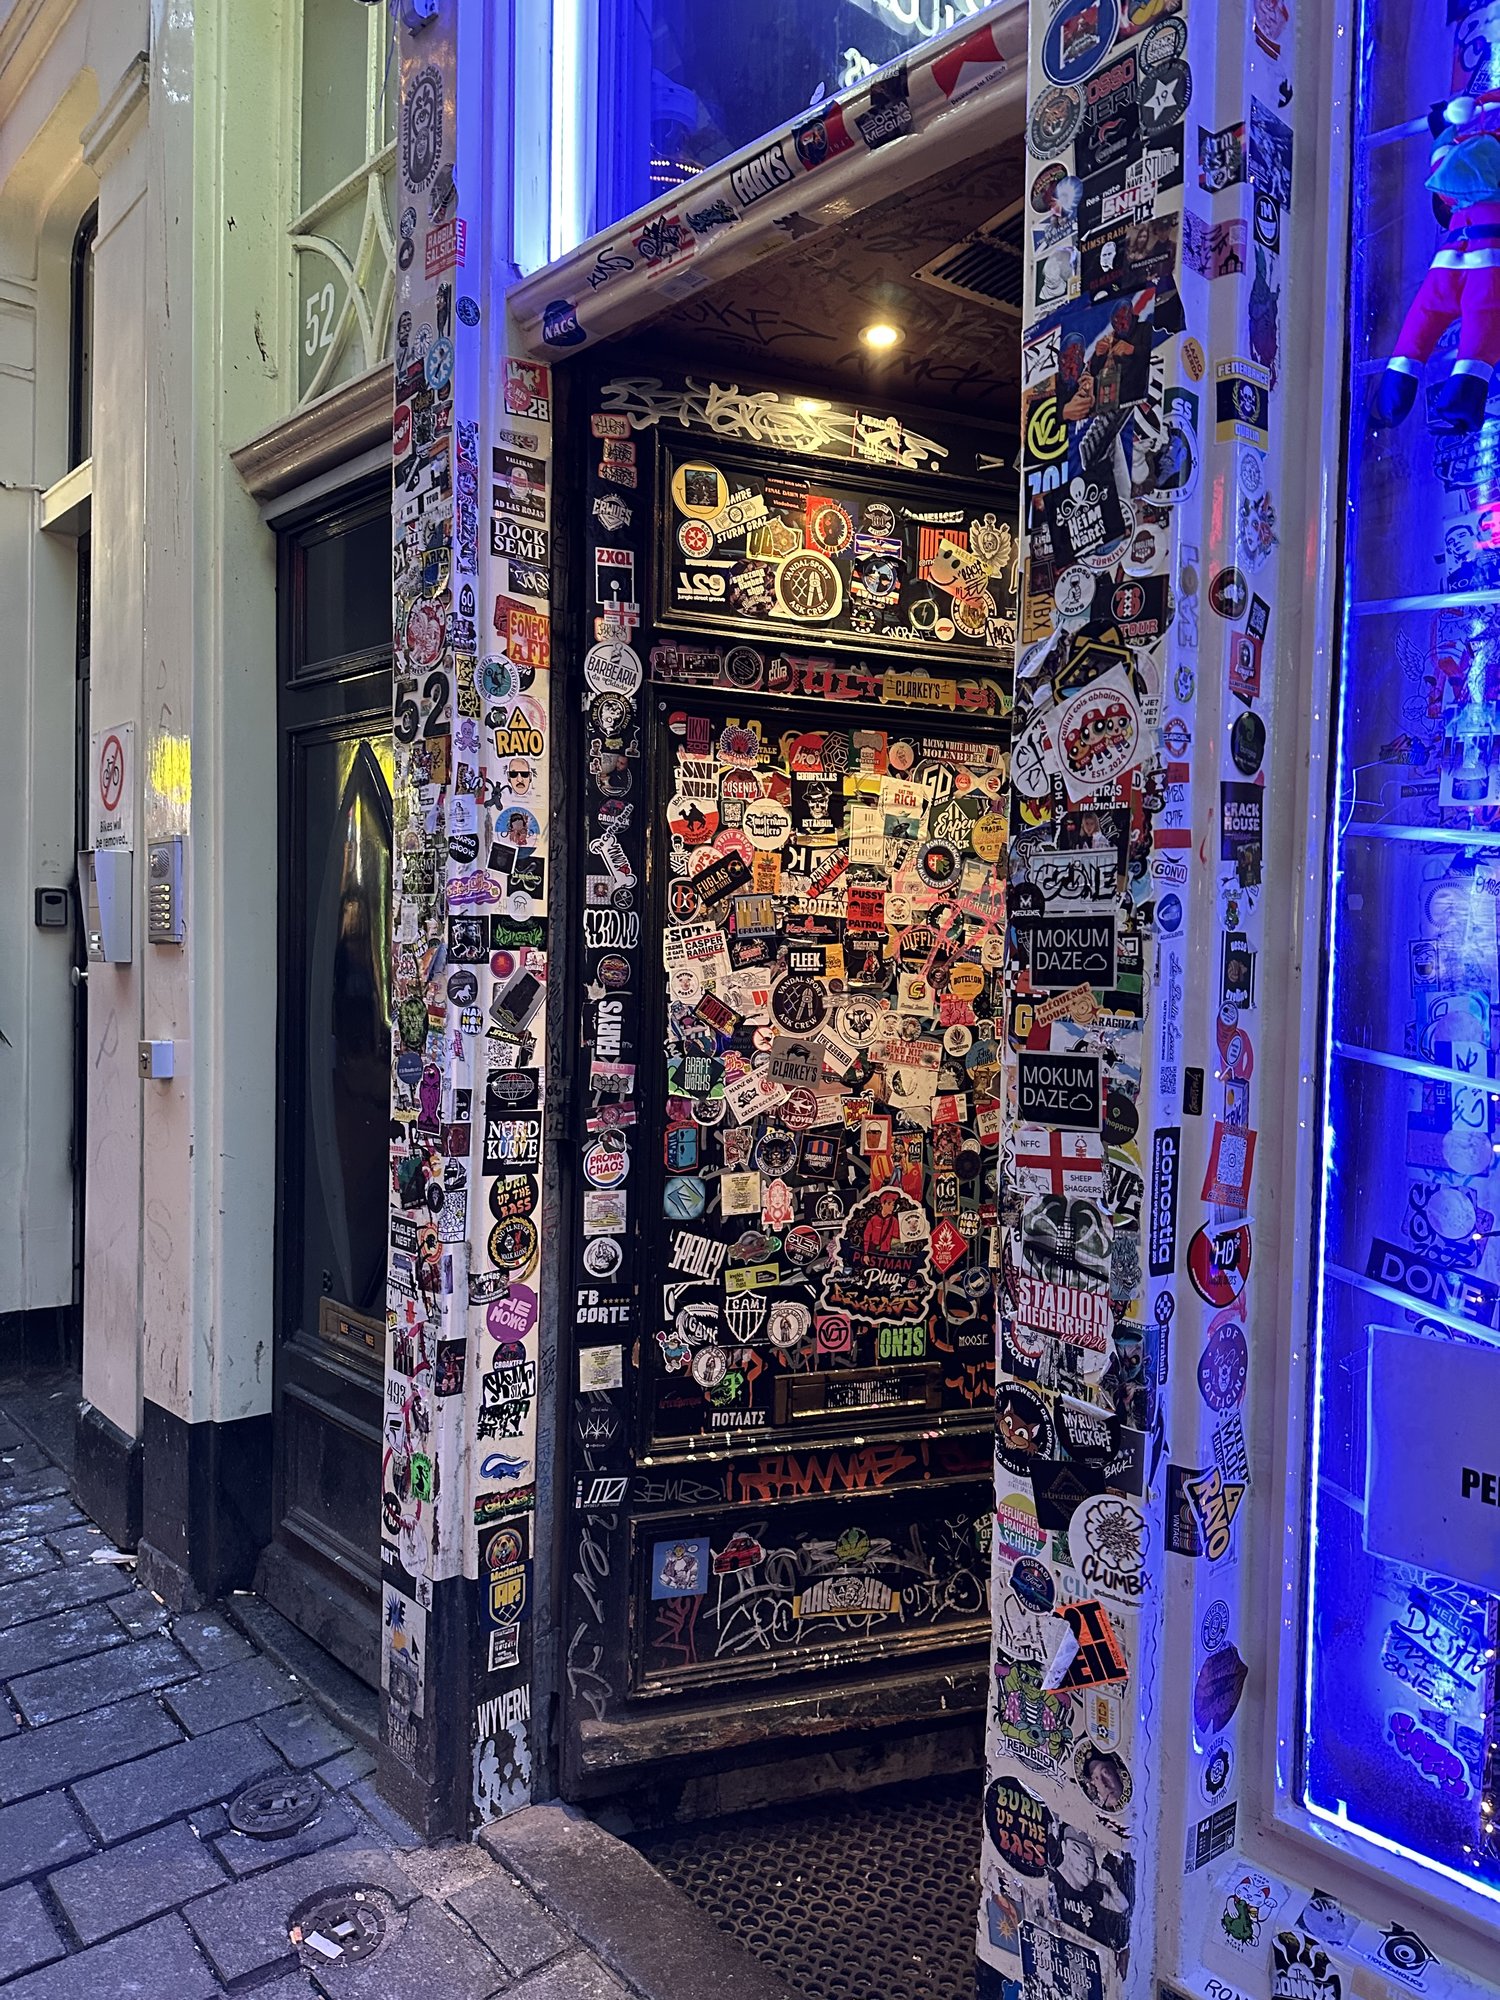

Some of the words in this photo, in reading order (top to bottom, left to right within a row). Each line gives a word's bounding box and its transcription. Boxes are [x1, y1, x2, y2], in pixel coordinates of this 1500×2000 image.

[862, 101, 907, 133] BORJA
[866, 110, 912, 143] MEGIAS
[736, 145, 793, 202] FARYS
[306, 283, 334, 357] 52
[545, 316, 576, 341] NACS
[1183, 345, 1200, 381] MERDA
[1188, 341, 1203, 373] LAZIO
[505, 454, 534, 470] VALLEKAS
[764, 486, 782, 495] FINAL
[494, 499, 505, 508] AD
[506, 502, 520, 513] LAS
[521, 505, 545, 519] ROJAS
[592, 497, 633, 526] ERWUES
[494, 520, 546, 547] DOCK
[716, 524, 746, 544] STURM
[746, 516, 767, 532] GRAZ
[493, 535, 546, 560] SEMP
[596, 549, 633, 566] ZXQL
[783, 560, 808, 582] VANDAL
[808, 560, 832, 581] SPORT
[460, 590, 474, 606] 60
[694, 594, 709, 602] street
[789, 599, 806, 616] ASK
[806, 600, 830, 617] CREW
[1064, 602, 1085, 614] BOYS
[460, 605, 474, 615] EAST
[587, 656, 637, 688] BARBEARIA
[768, 666, 787, 681] CLUB
[895, 679, 941, 700] CLARKEY'S
[1087, 691, 1121, 703] abhainn
[395, 671, 450, 744] 52
[496, 730, 544, 756] RAYO
[922, 738, 944, 749] RACING
[945, 739, 963, 751] WHITE
[681, 761, 719, 779] SNP
[1091, 769, 1108, 780] EST.
[1109, 754, 1127, 772] 2024
[681, 780, 718, 798] NBB
[723, 780, 758, 794] COSENZA
[894, 793, 916, 806] RICH
[1223, 802, 1260, 816] CRACK
[100, 820, 113, 834] Bikes
[113, 817, 122, 831] will
[603, 823, 619, 842] Coffee
[934, 808, 976, 838] Espen
[1223, 817, 1260, 831] HOUSE
[95, 836, 103, 848] be
[449, 842, 476, 859] GROOVE
[696, 867, 729, 894] FUGLAS
[1155, 863, 1185, 880] GONVI
[851, 890, 884, 900] PUSSY
[799, 898, 849, 916] ROUEN
[849, 919, 884, 930] PATROL
[685, 936, 723, 950] CASPER
[1036, 928, 1109, 949] MOKUM
[686, 944, 725, 958] RAMIREZ
[1036, 952, 1083, 971] DAZE
[778, 976, 805, 995] VANDAL
[805, 977, 824, 997] SPORT
[596, 1000, 623, 1056] FARYS
[779, 1012, 794, 1028] ASK
[795, 1015, 818, 1029] CREW
[886, 1044, 903, 1054] SIND
[907, 1047, 924, 1057] NIE
[888, 1053, 920, 1064] ALLEIN
[772, 1060, 818, 1082] CLARKEY'S
[1023, 1066, 1094, 1088] MOKUM
[728, 1082, 746, 1094] MAINZ
[1024, 1087, 1069, 1109] DAZE
[790, 1115, 814, 1124] ROVER
[488, 1120, 539, 1140] NORD
[486, 1138, 538, 1161] KURVE
[1020, 1139, 1041, 1149] NFFC
[588, 1161, 624, 1176] CHAOS
[1070, 1174, 1093, 1183] SHEEP
[496, 1175, 528, 1194] BURN
[1064, 1184, 1102, 1194] SHAGGERS
[497, 1191, 511, 1206] UP
[512, 1189, 531, 1203] THE
[501, 1198, 532, 1217] BASS
[1158, 1136, 1174, 1264] donostia
[391, 1220, 417, 1238] EAGLE'S
[395, 1234, 412, 1248] NEST
[578, 1290, 599, 1305] FB
[732, 1299, 760, 1310] CAM
[1019, 1276, 1109, 1327] STADION
[576, 1306, 630, 1324] CORTE
[1018, 1302, 1108, 1339] NIEDERRHEIN
[1219, 1328, 1240, 1341] ADF
[1004, 1331, 1037, 1369] HOCKEY
[387, 1378, 406, 1407] 493
[1006, 1384, 1042, 1407] BREWERY
[1203, 1365, 1246, 1408] BOTTICINO
[1104, 1456, 1134, 1479] BACK!
[1461, 1465, 1500, 1508] PE
[1193, 1470, 1231, 1561] RAYO
[1003, 1517, 1040, 1541] BRAUCHEN
[1172, 1513, 1180, 1547] VINTAGE
[1003, 1528, 1038, 1555] SCHUTZ
[490, 1562, 525, 1582] Modena
[1021, 1560, 1051, 1581] EUSKADI
[1081, 1554, 1153, 1596] CLUMBA
[1018, 1592, 1041, 1612] TALDEA
[1431, 1603, 1471, 1635] HELLO
[477, 1683, 531, 1743] WYVERN
[997, 1785, 1043, 1823] BURN
[996, 1808, 1014, 1825] UP
[1018, 1817, 1046, 1842] THE
[1199, 1822, 1210, 1833] 44
[999, 1830, 1046, 1867] BASS
[1032, 1947, 1093, 1990] Hooligans
[1064, 1944, 1099, 1974] Sofia
